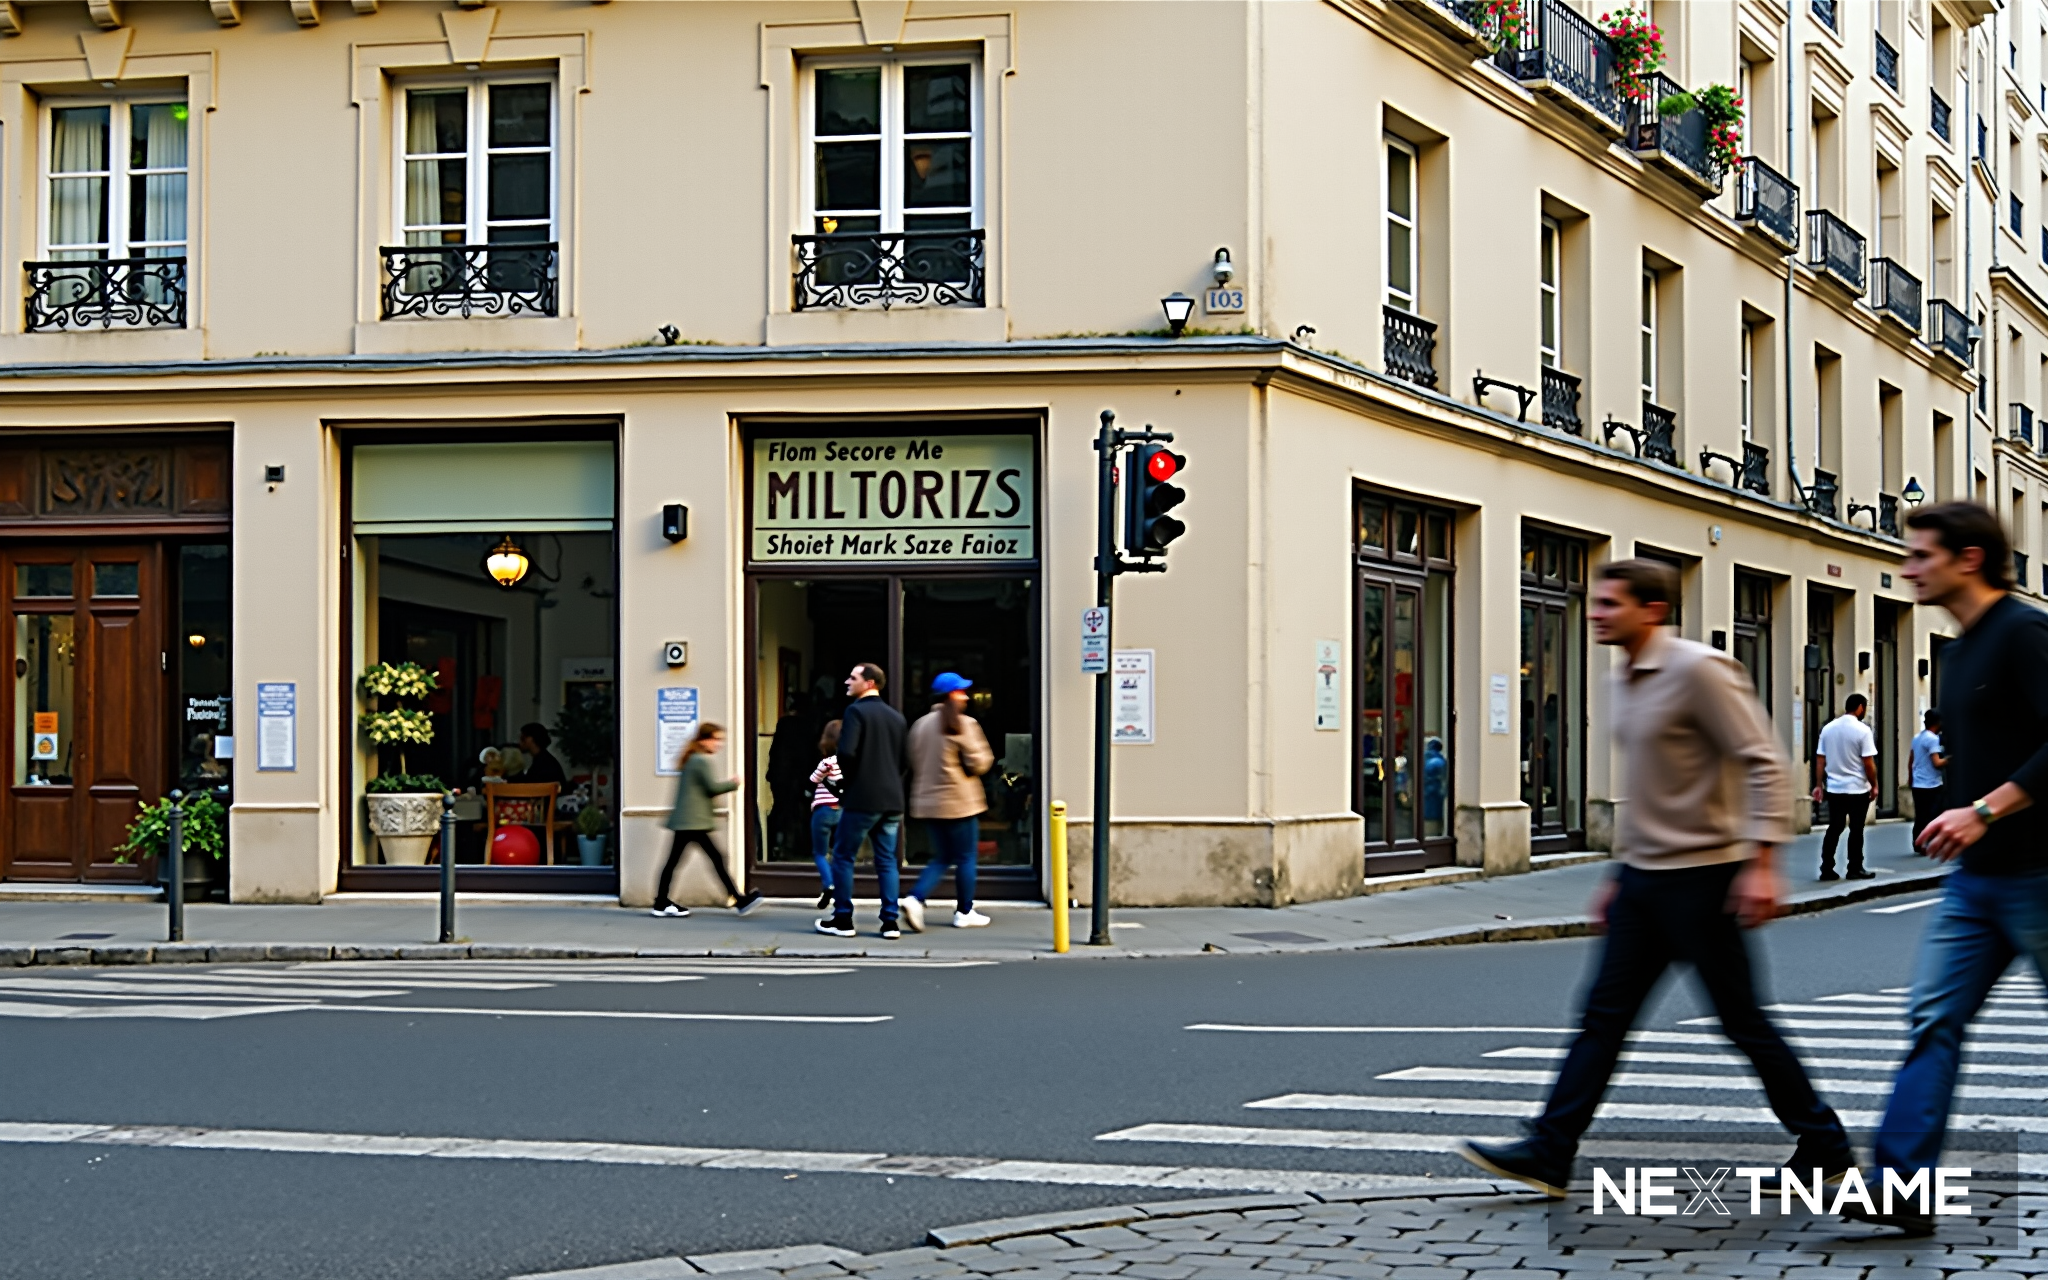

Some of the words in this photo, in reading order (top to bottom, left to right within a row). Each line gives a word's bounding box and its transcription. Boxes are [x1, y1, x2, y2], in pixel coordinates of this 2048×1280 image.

[1210, 290, 1243, 309] 103
[768, 441, 816, 462] Flom
[824, 440, 896, 461] Secore
[905, 440, 943, 460] Me
[767, 469, 1021, 520] MILTORIZS
[766, 533, 834, 555] Shoiet
[840, 533, 898, 555] Mark
[903, 534, 953, 554] Saze
[961, 533, 1018, 555] Faioz
